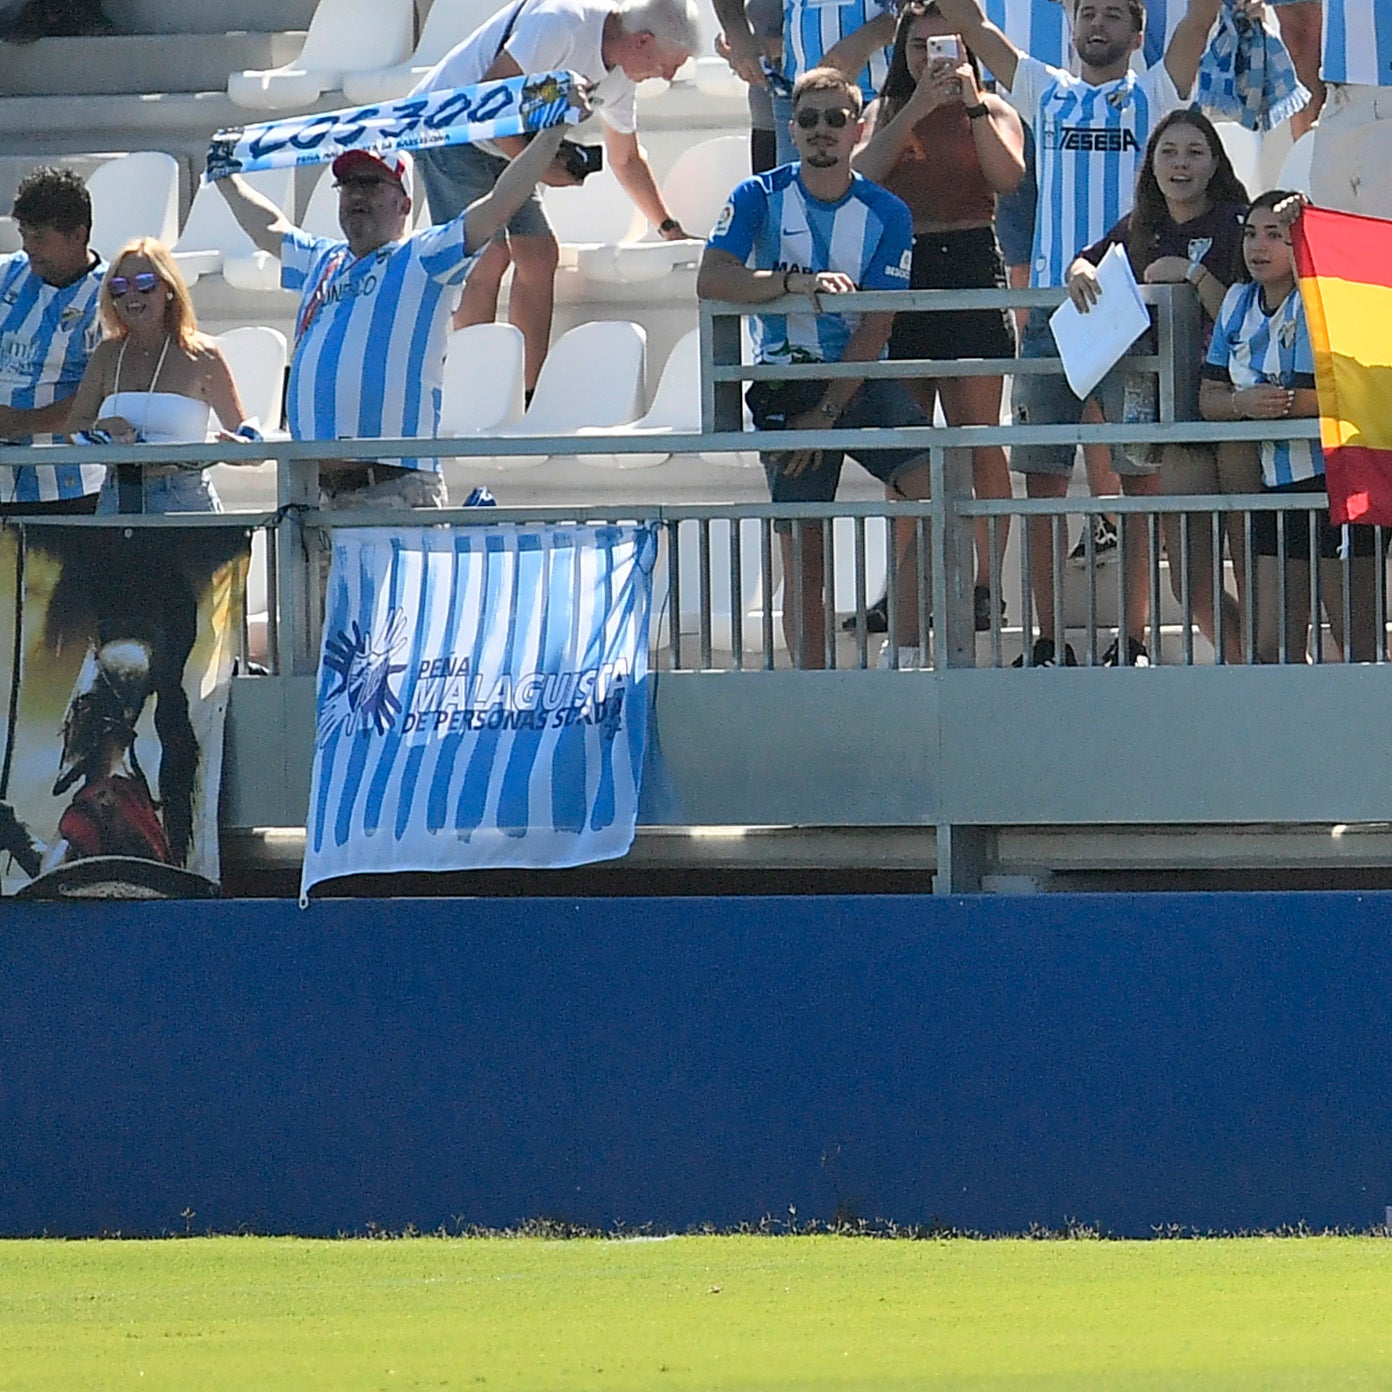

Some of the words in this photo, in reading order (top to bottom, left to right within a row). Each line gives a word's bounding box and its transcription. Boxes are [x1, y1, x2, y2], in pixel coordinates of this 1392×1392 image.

[1059, 127, 1140, 151] TESESA
[409, 656, 629, 713] MALAGUISTA
[401, 710, 428, 734] DE
[433, 708, 548, 733] PERSONAS
